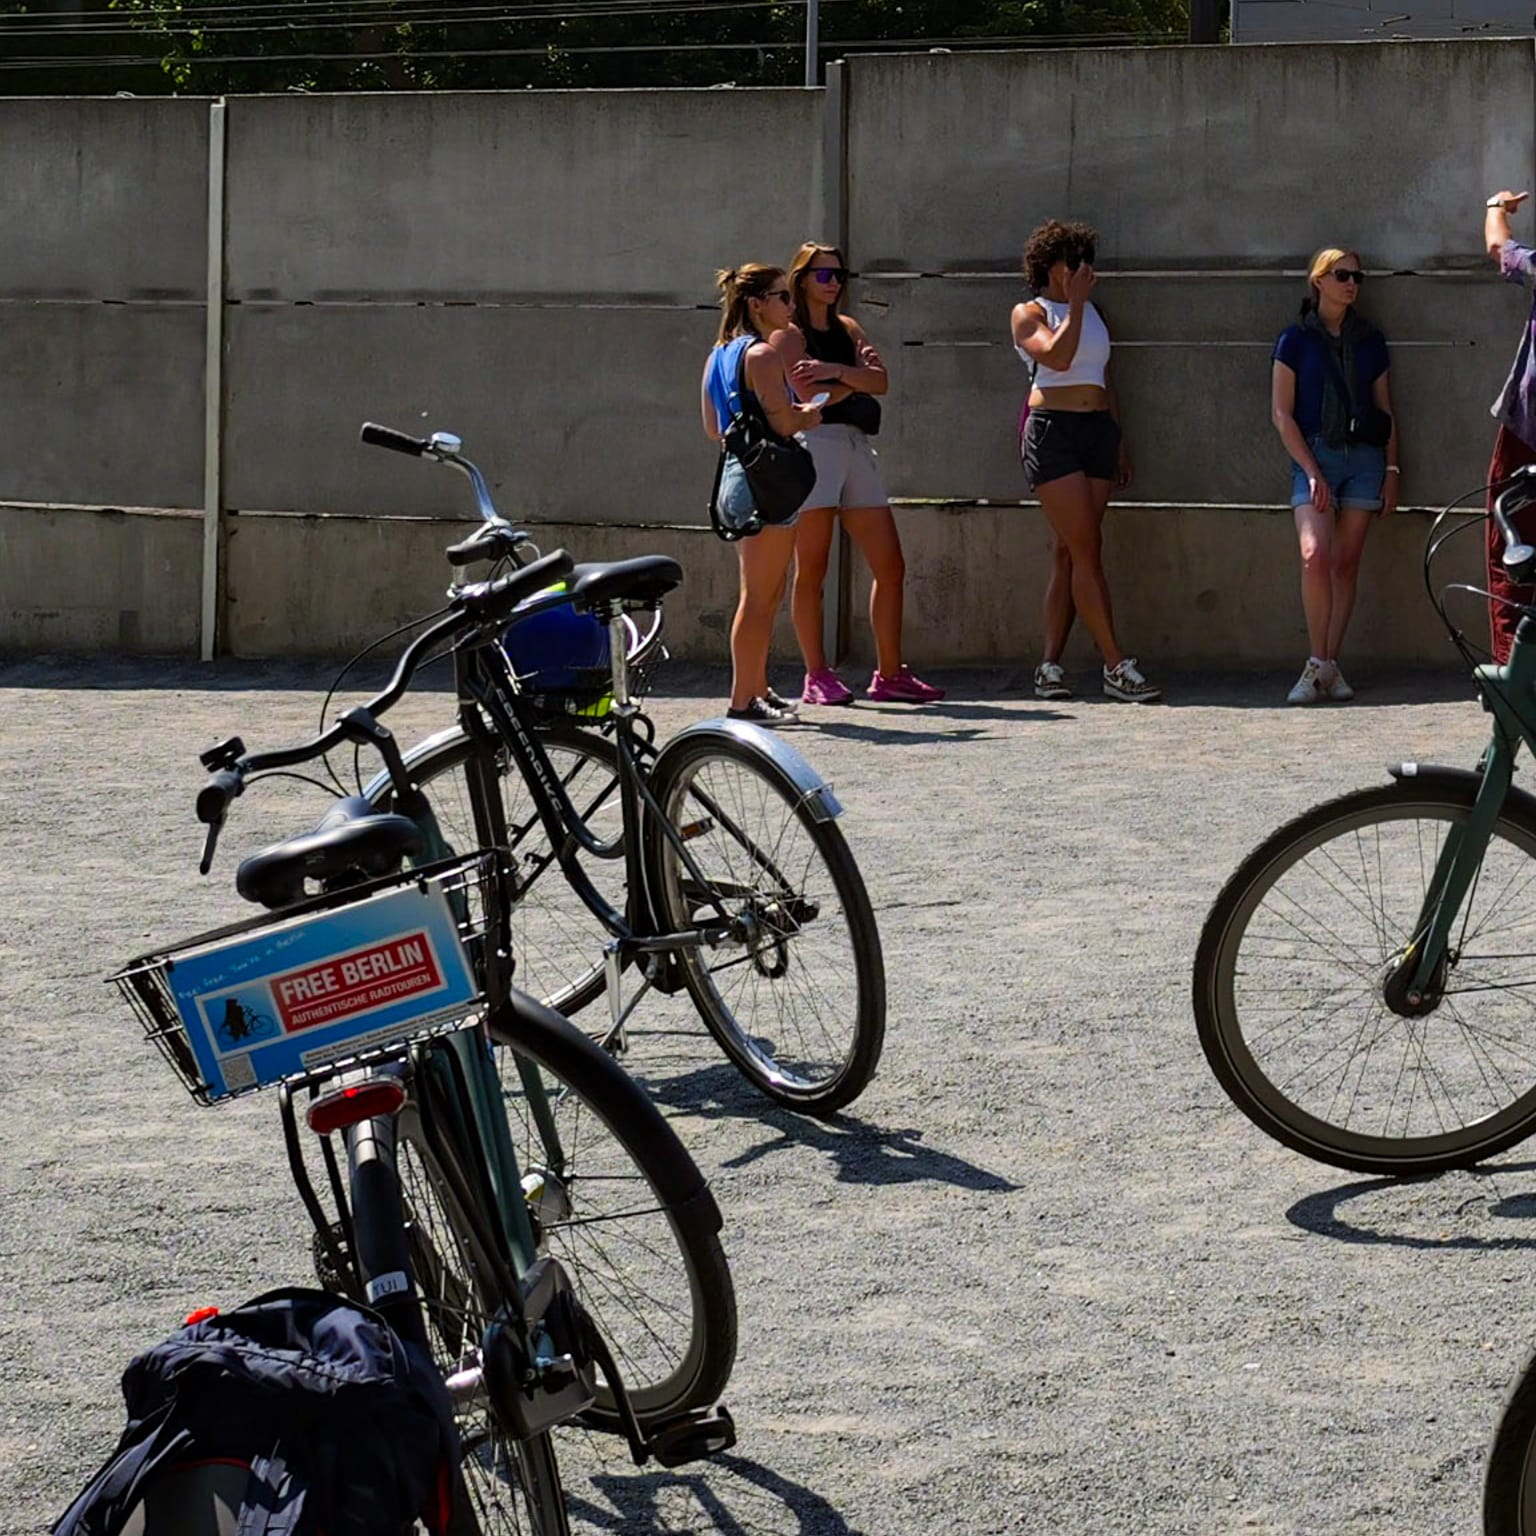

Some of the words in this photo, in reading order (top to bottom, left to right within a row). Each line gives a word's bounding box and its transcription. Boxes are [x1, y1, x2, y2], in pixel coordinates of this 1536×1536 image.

[279, 971, 339, 1005] FREE
[343, 940, 425, 985] BERLIN
[290, 992, 369, 1027] AUTHENTISCHE
[368, 973, 432, 1004] RADTOUREN
